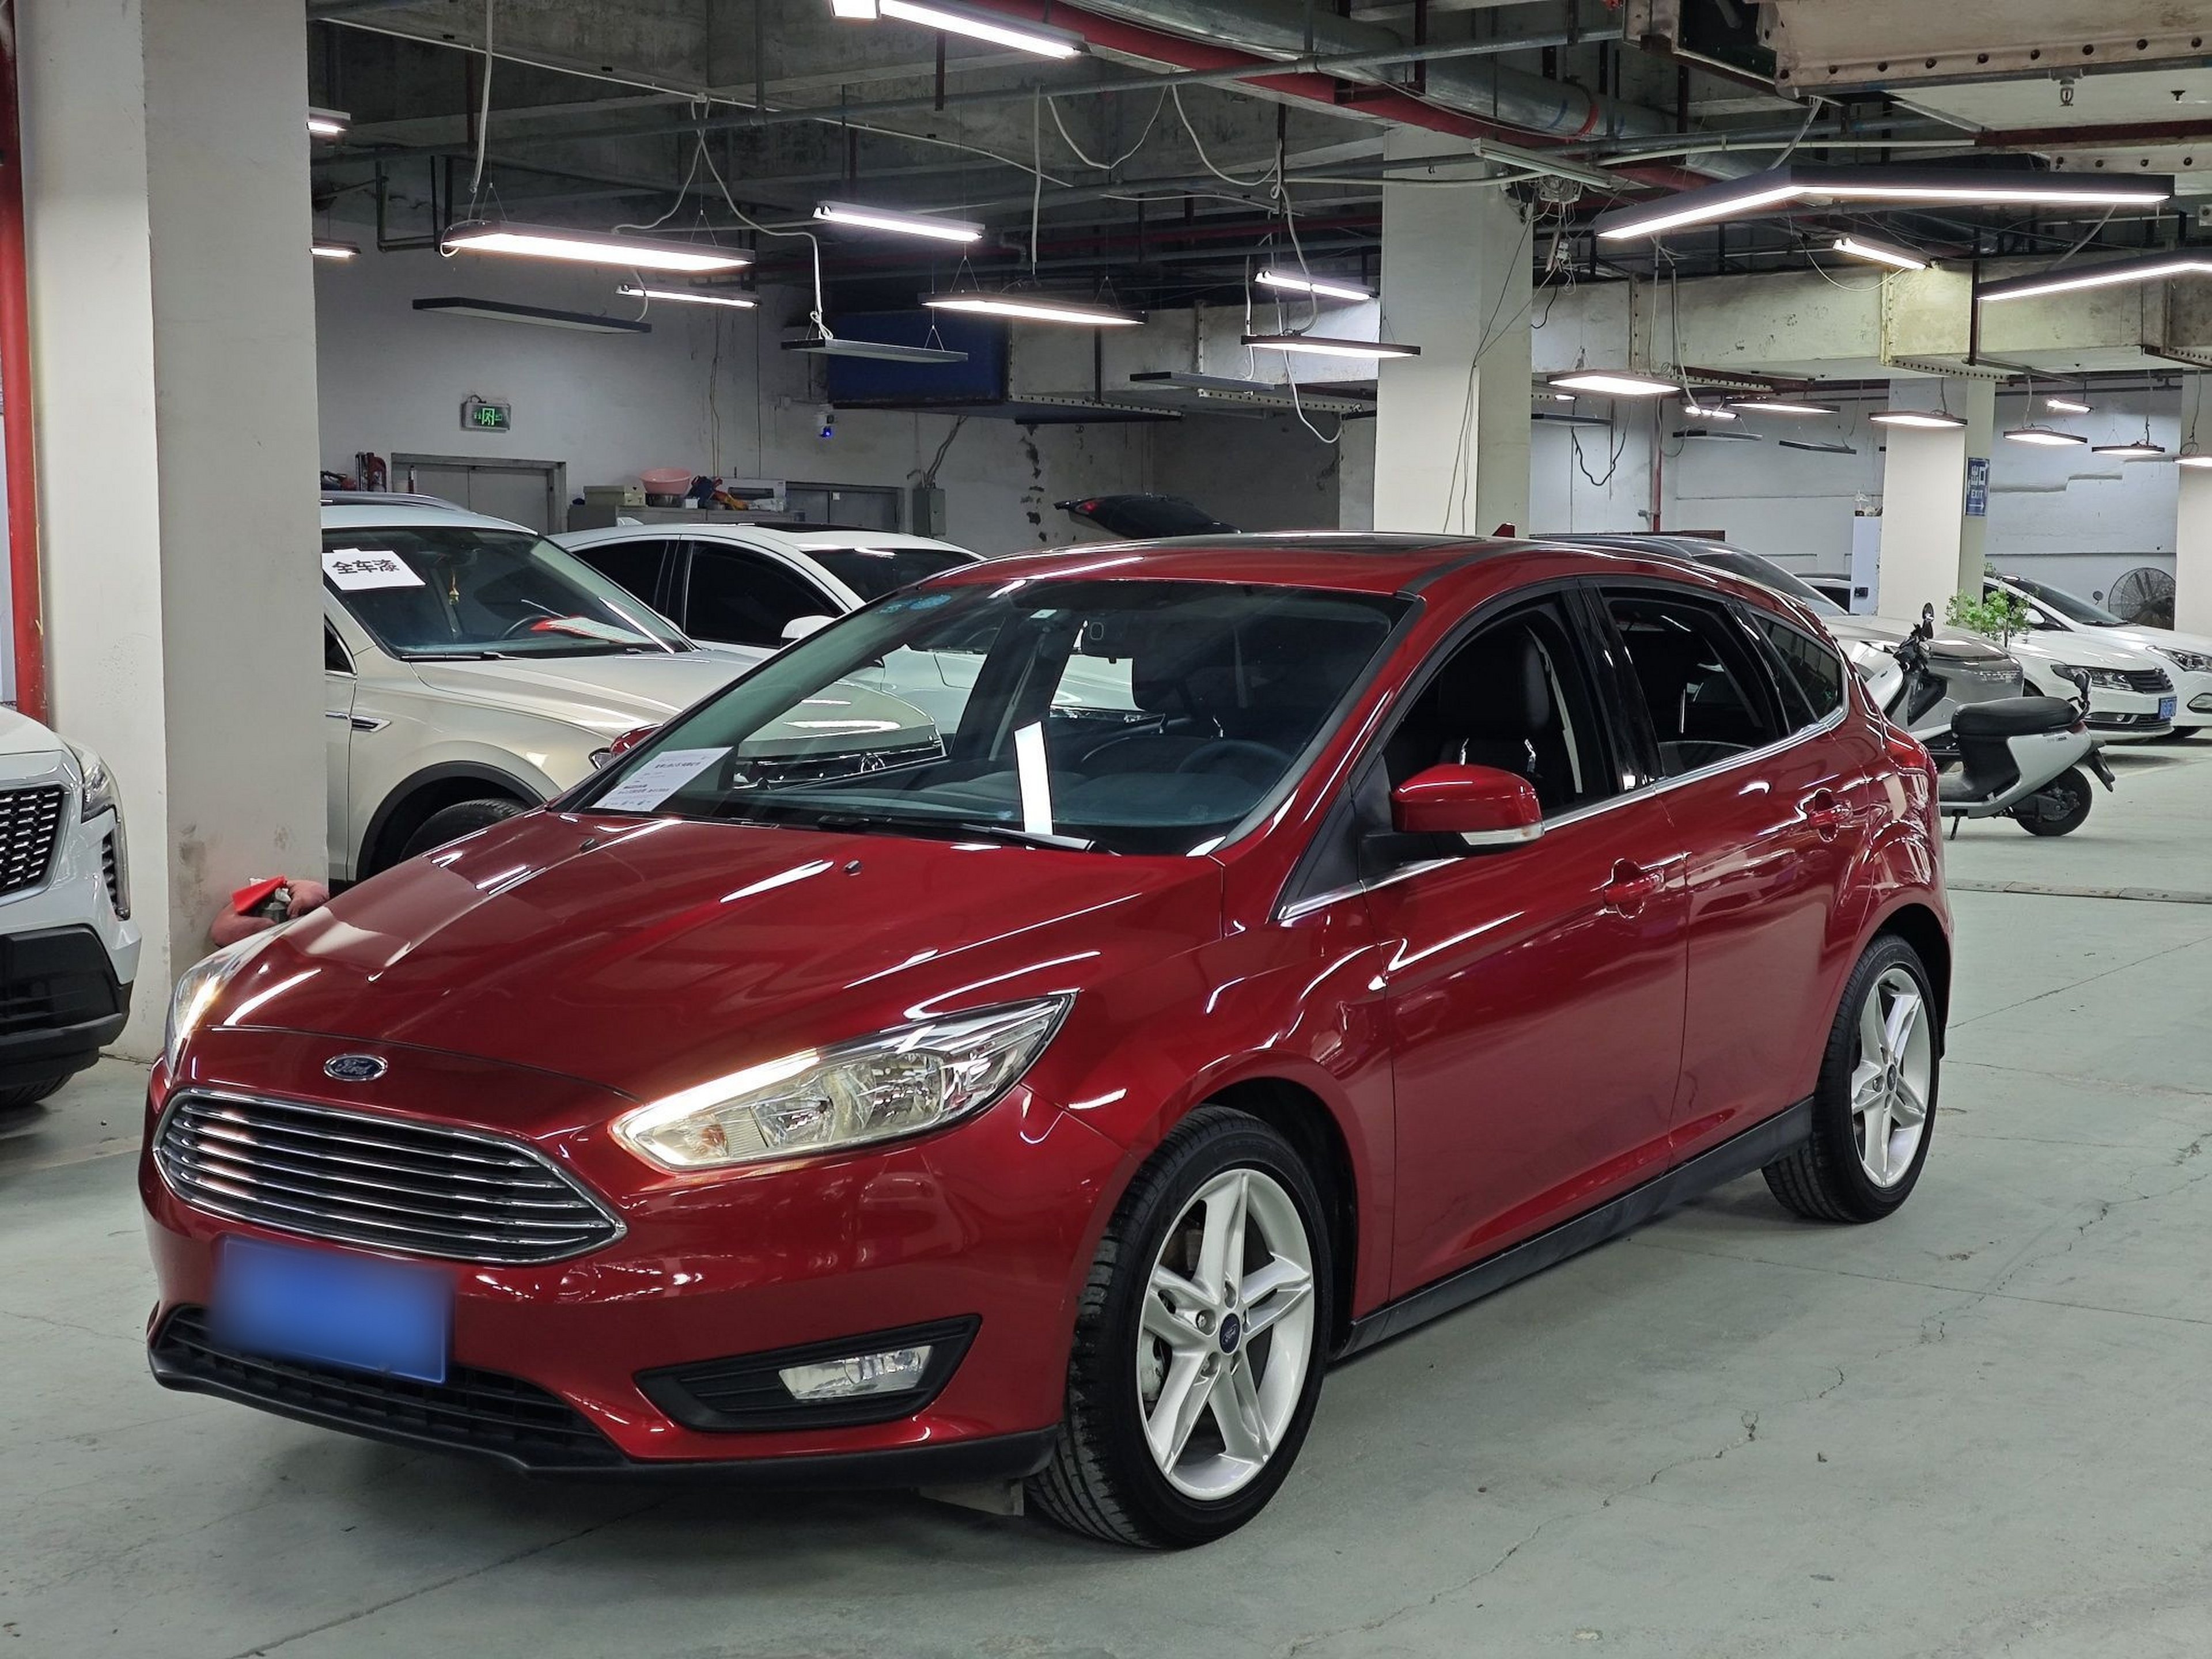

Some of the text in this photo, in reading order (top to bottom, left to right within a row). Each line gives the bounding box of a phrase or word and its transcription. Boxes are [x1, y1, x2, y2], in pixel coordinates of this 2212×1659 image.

[1970, 465, 1986, 486] 出口
[1971, 490, 1983, 499] EXIT
[332, 559, 400, 574] 全车漆
[334, 1058, 373, 1075] Ford
